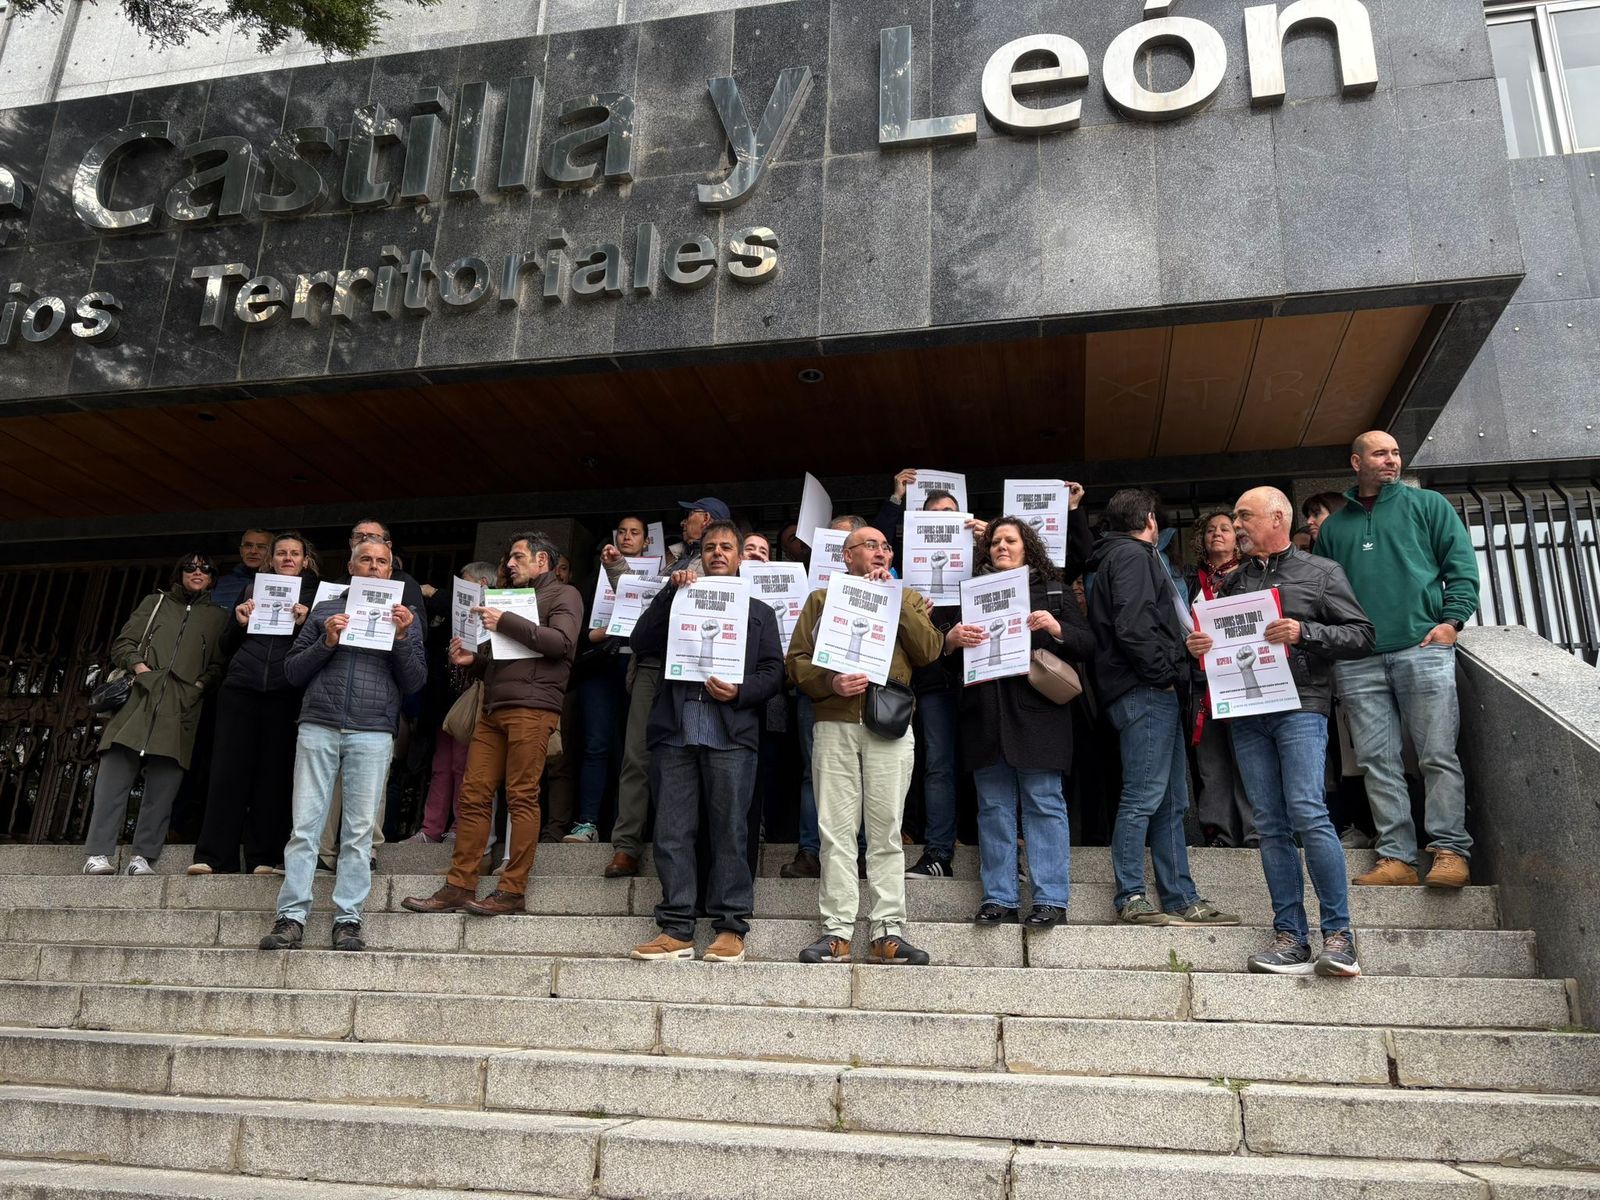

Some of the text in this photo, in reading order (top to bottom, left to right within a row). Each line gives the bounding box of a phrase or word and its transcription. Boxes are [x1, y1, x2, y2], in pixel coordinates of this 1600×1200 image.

[72, 76, 637, 230] Castilla
[697, 66, 812, 209] y
[879, 0, 1378, 150] León
[191, 223, 781, 331] Territoriales
